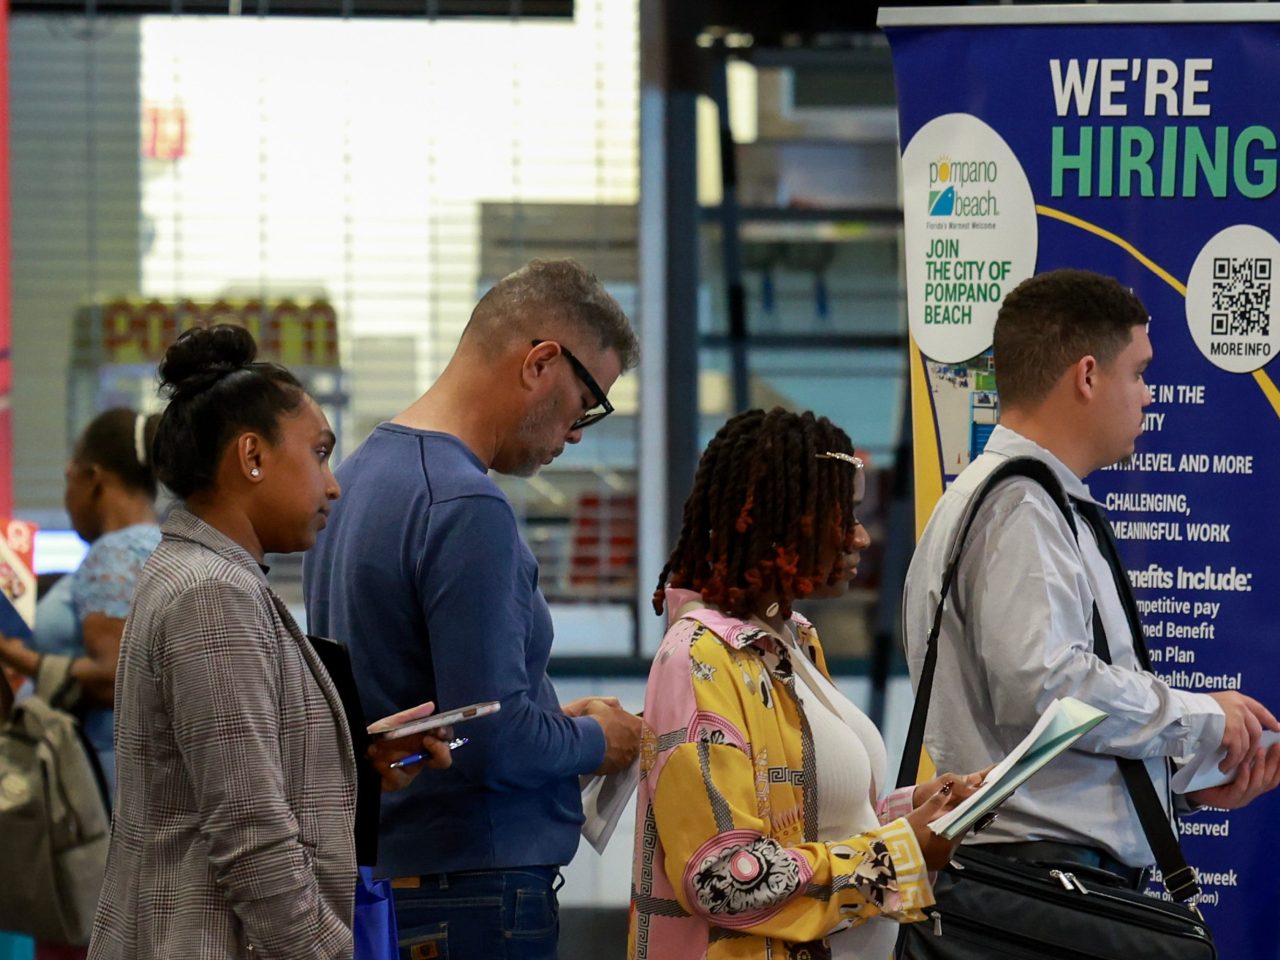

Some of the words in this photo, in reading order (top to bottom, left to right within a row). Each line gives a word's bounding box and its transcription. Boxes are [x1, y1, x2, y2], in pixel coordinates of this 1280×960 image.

[1049, 58, 1214, 117] WE'RE
[1051, 125, 1278, 199] HIRING
[929, 160, 998, 188] pompano
[926, 239, 959, 258] JOIN
[925, 261, 952, 280] THE
[954, 261, 985, 280] CITY
[988, 261, 1012, 280] OF
[924, 283, 1001, 302] POMPANO
[924, 305, 972, 325] BEACH
[1210, 342, 1243, 356] MORE
[1244, 343, 1271, 356] INFO
[1159, 385, 1174, 403] IN
[1177, 385, 1205, 404] THE
[1142, 413, 1165, 431] ITY
[1179, 454, 1210, 473] AND
[1213, 455, 1254, 474] MORE
[1106, 493, 1191, 516] CHALLENGING,
[1110, 521, 1183, 541] MEANINGFUL
[1186, 523, 1231, 542] WORK
[1177, 565, 1253, 592] Include:
[1193, 602, 1220, 619] pay
[1141, 620, 1163, 637] ned
[1166, 622, 1215, 639] Benefit
[1165, 646, 1195, 663] Plan
[1155, 670, 1242, 690] ealth/Dental
